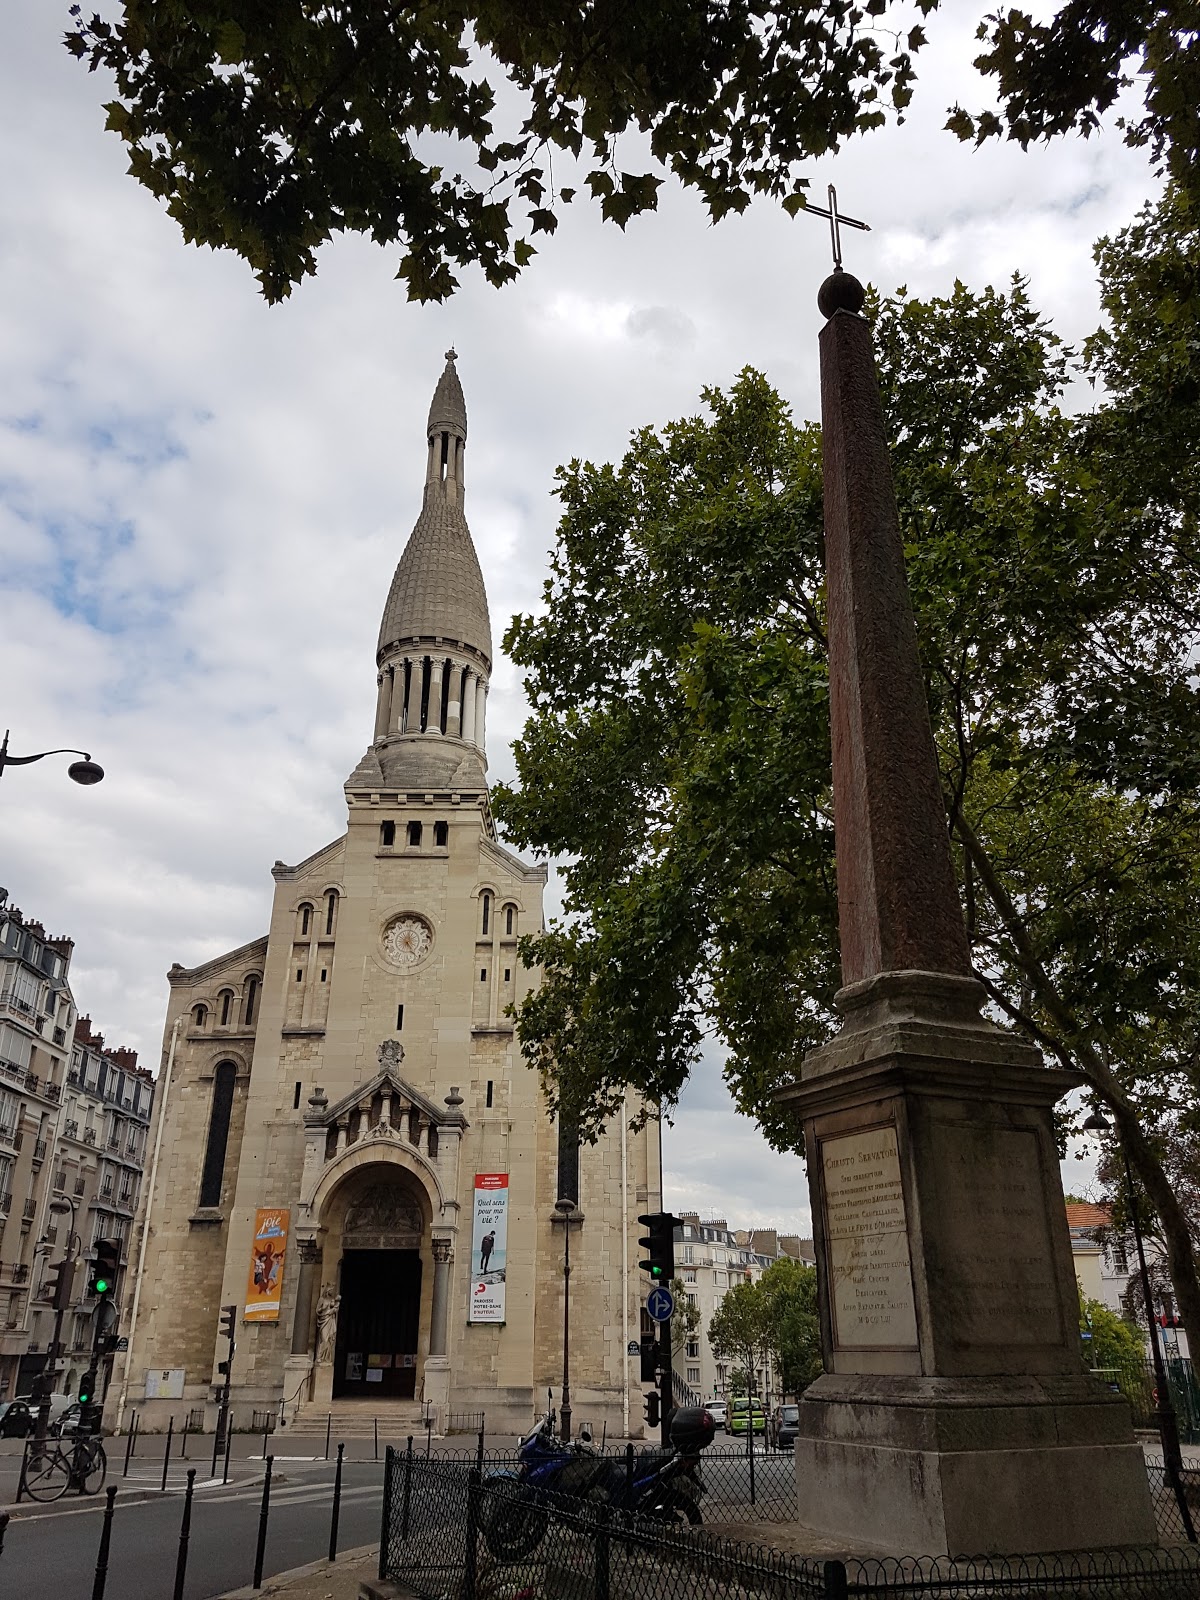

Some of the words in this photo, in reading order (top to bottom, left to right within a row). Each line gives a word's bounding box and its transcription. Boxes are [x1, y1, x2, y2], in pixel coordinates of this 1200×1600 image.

[477, 1199, 492, 1207] Quel
[482, 1215, 493, 1224] vie
[257, 1216, 282, 1235] joie
